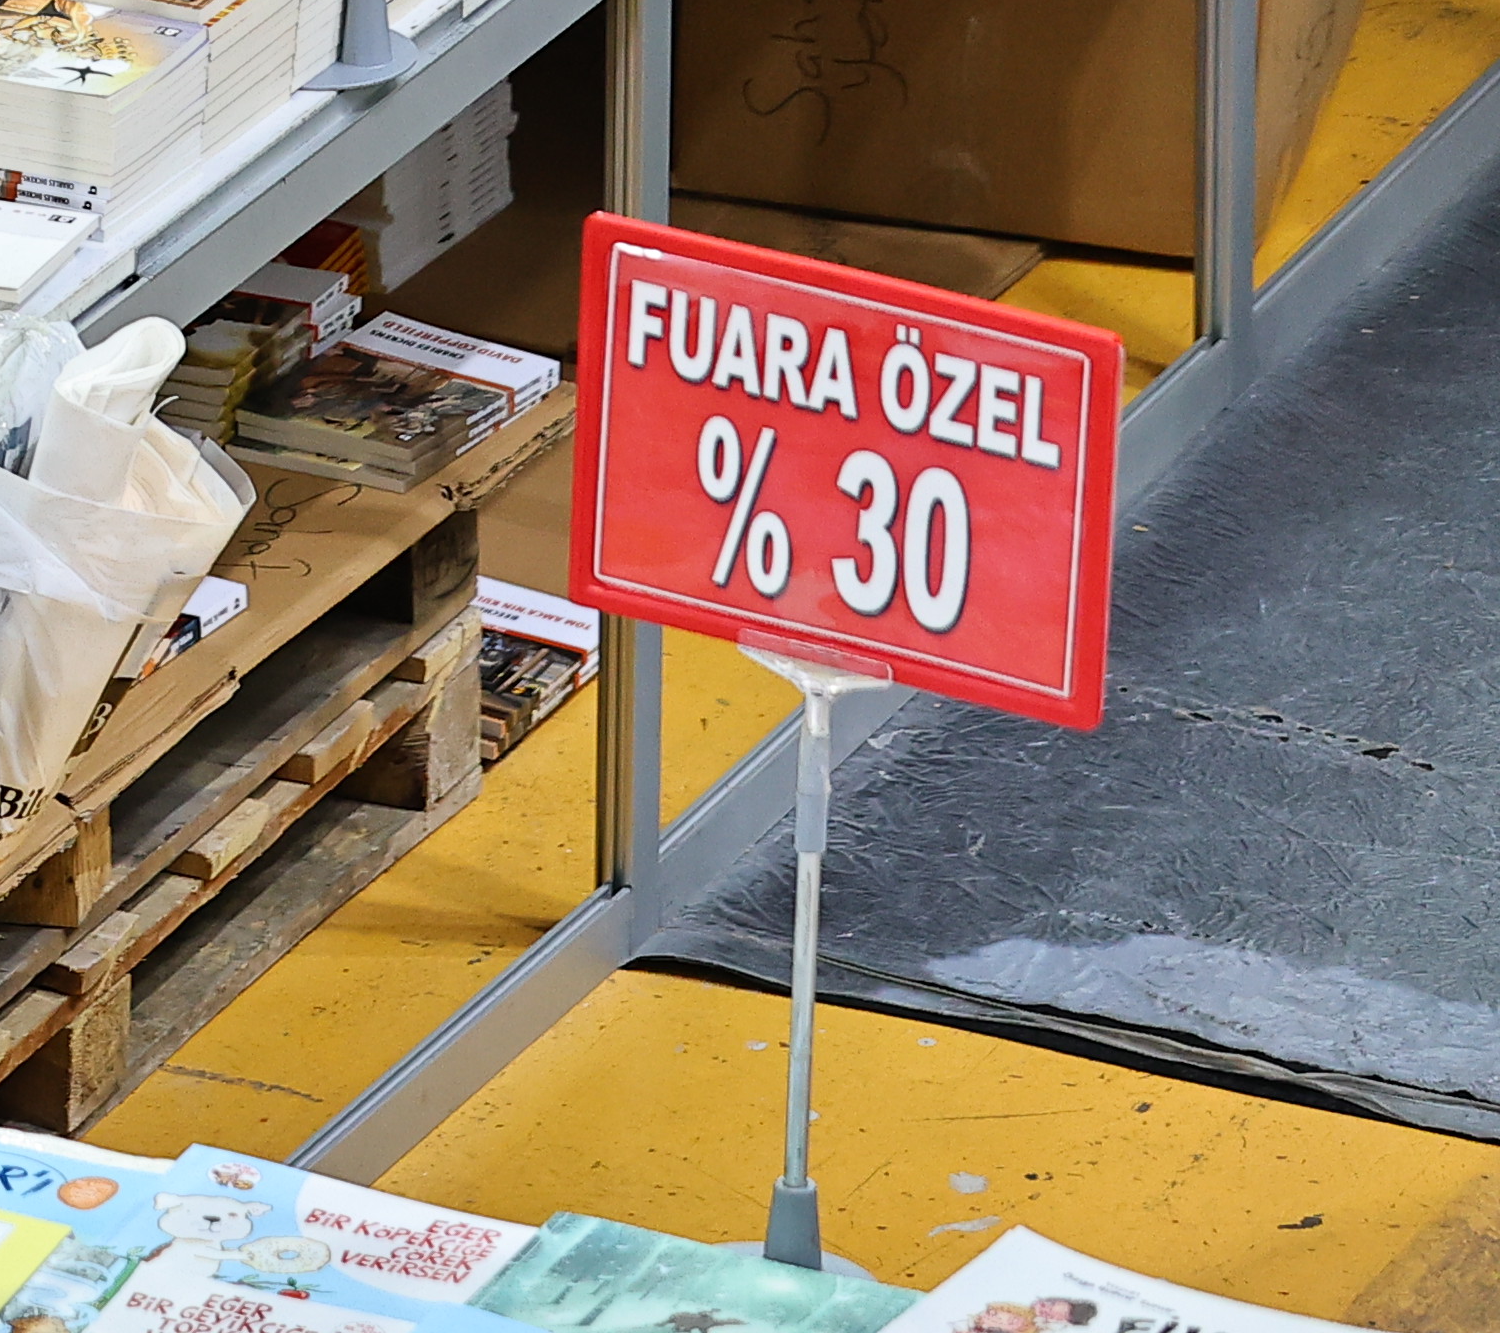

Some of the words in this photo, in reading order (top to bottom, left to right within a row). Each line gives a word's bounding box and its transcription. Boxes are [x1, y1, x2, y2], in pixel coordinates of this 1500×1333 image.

[380, 317, 478, 354] COPPERFIELD
[479, 345, 522, 366] DAVID
[627, 278, 859, 422] FUARA
[880, 323, 1062, 469] ÖZEL
[697, 414, 791, 598] %
[832, 448, 970, 633] 30
[424, 1219, 502, 1245] EĞER
[126, 1291, 176, 1314] BİR
[201, 1293, 274, 1319] EĞER
